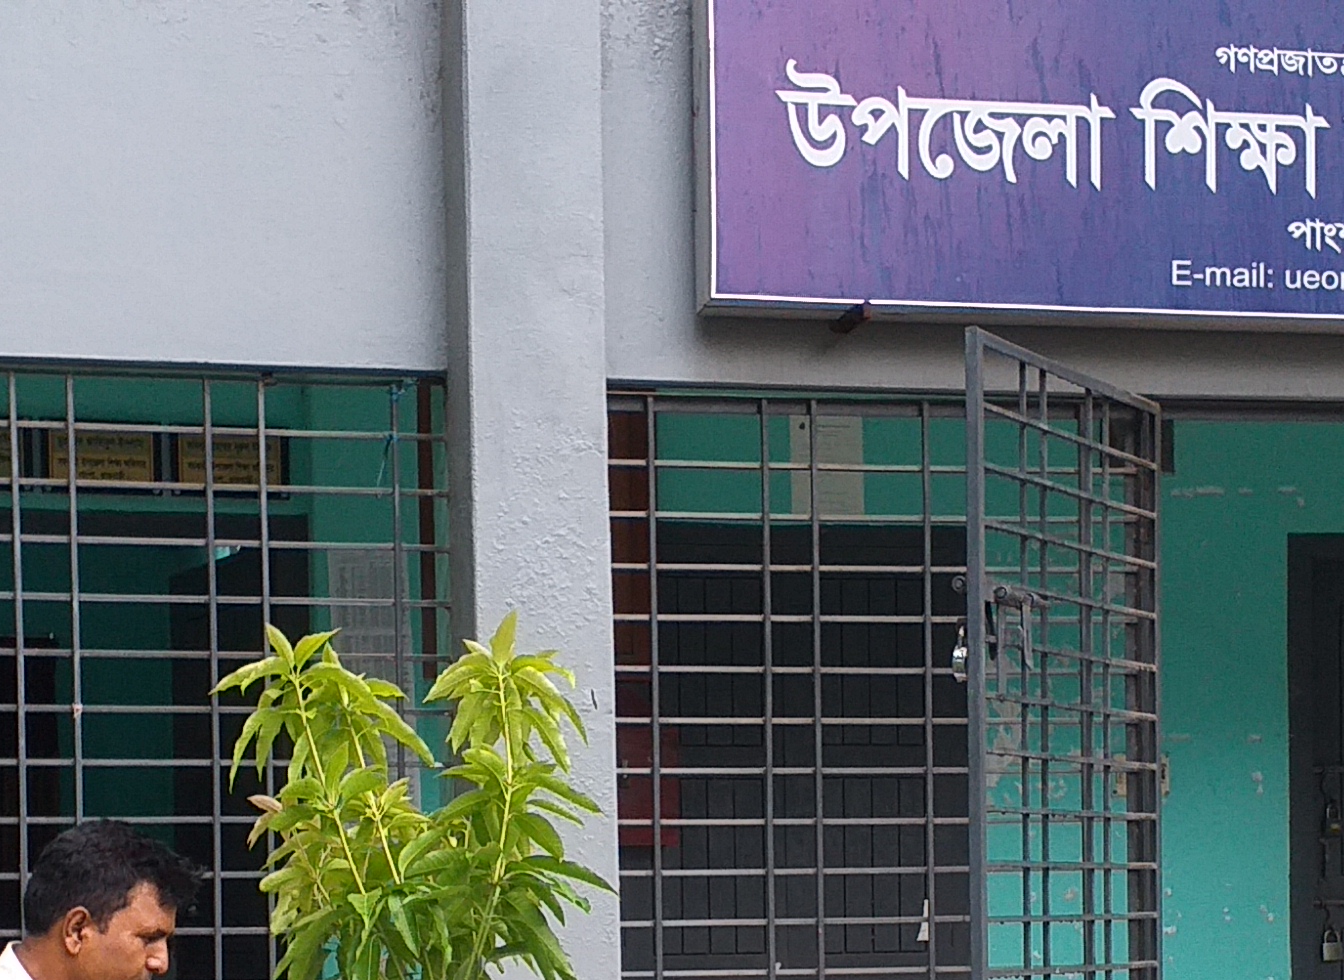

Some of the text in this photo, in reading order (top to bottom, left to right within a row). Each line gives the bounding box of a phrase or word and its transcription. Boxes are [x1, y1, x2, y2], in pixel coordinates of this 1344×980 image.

[774, 58, 1116, 192] উপজেলা
[1129, 77, 1331, 199] শিক্ষা
[1171, 259, 1274, 289] E-mail:
